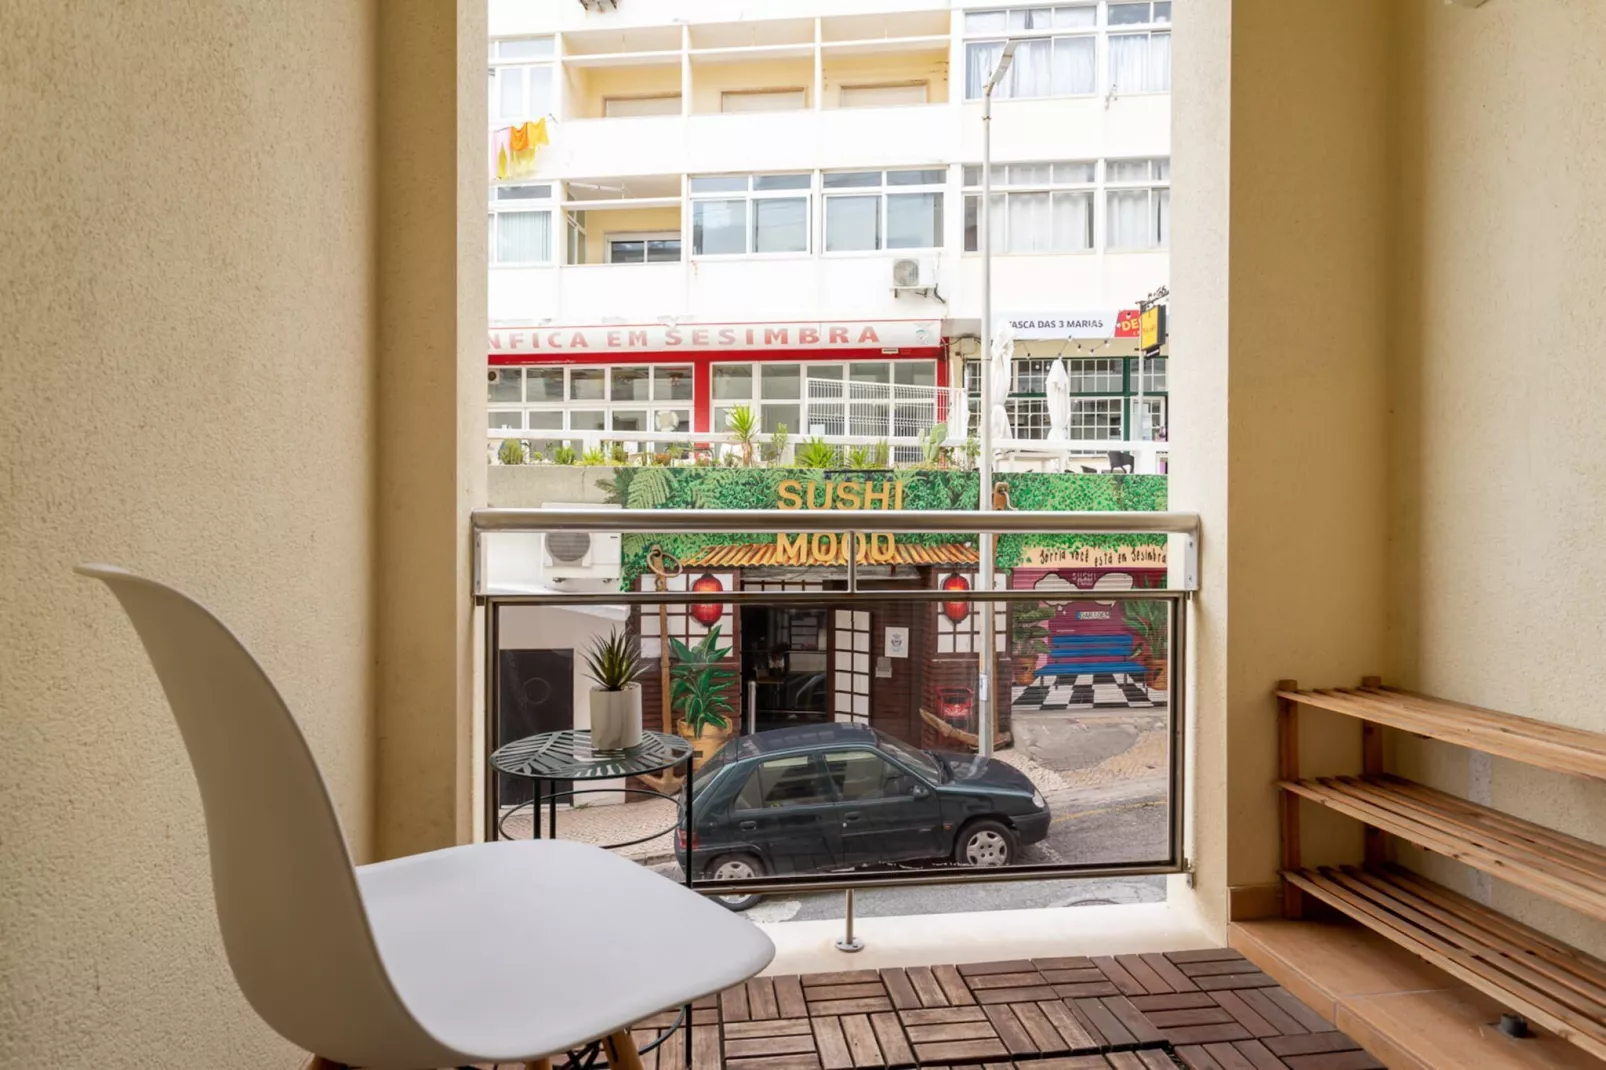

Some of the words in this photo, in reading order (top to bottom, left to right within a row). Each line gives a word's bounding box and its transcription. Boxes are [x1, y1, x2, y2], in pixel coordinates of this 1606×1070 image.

[607, 331, 647, 347] EM
[665, 326, 880, 346] SESIMBRA
[1009, 320, 1035, 328] ASCA
[1038, 320, 1056, 328] DAS
[1058, 320, 1064, 328] 3
[1066, 320, 1103, 328] MARIAS
[777, 479, 904, 510] SUSHI
[776, 532, 896, 563] MOOD
